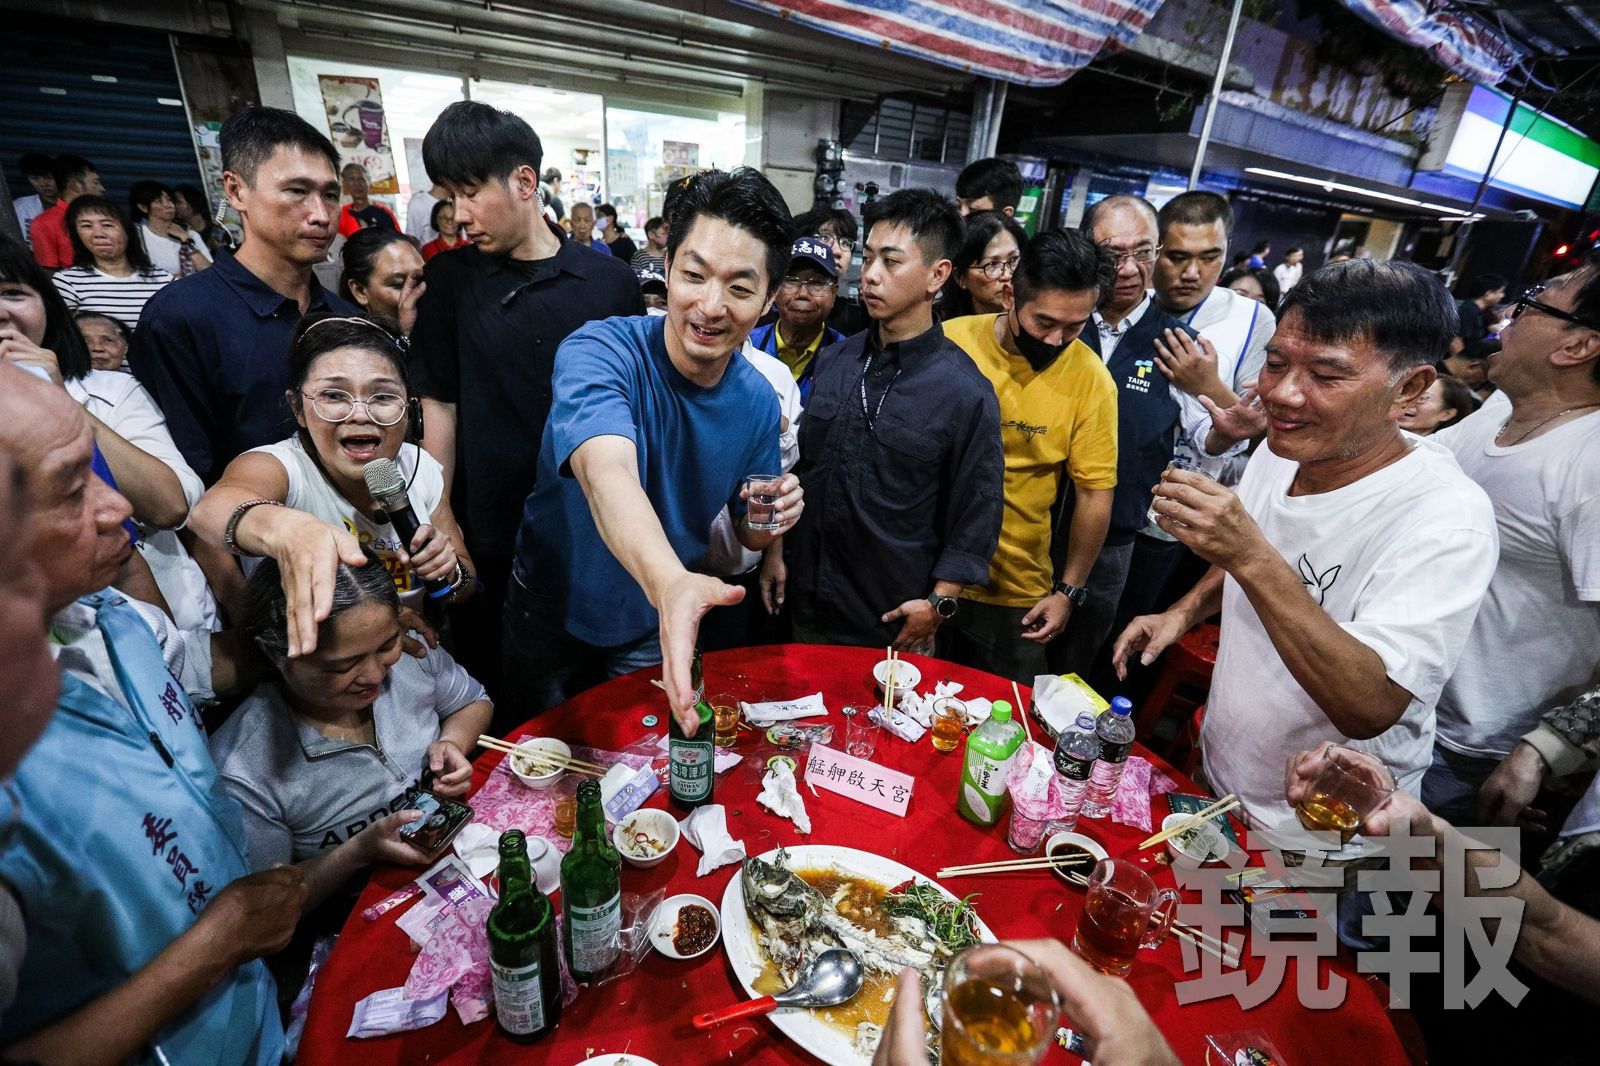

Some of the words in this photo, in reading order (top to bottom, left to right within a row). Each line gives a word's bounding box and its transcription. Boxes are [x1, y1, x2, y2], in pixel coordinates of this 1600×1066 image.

[1127, 376, 1151, 388] TAIPEI
[671, 761, 708, 778] 台灣啤酒
[677, 781, 700, 789] TAIWAN
[807, 756, 909, 804] 艋舺啟天宮
